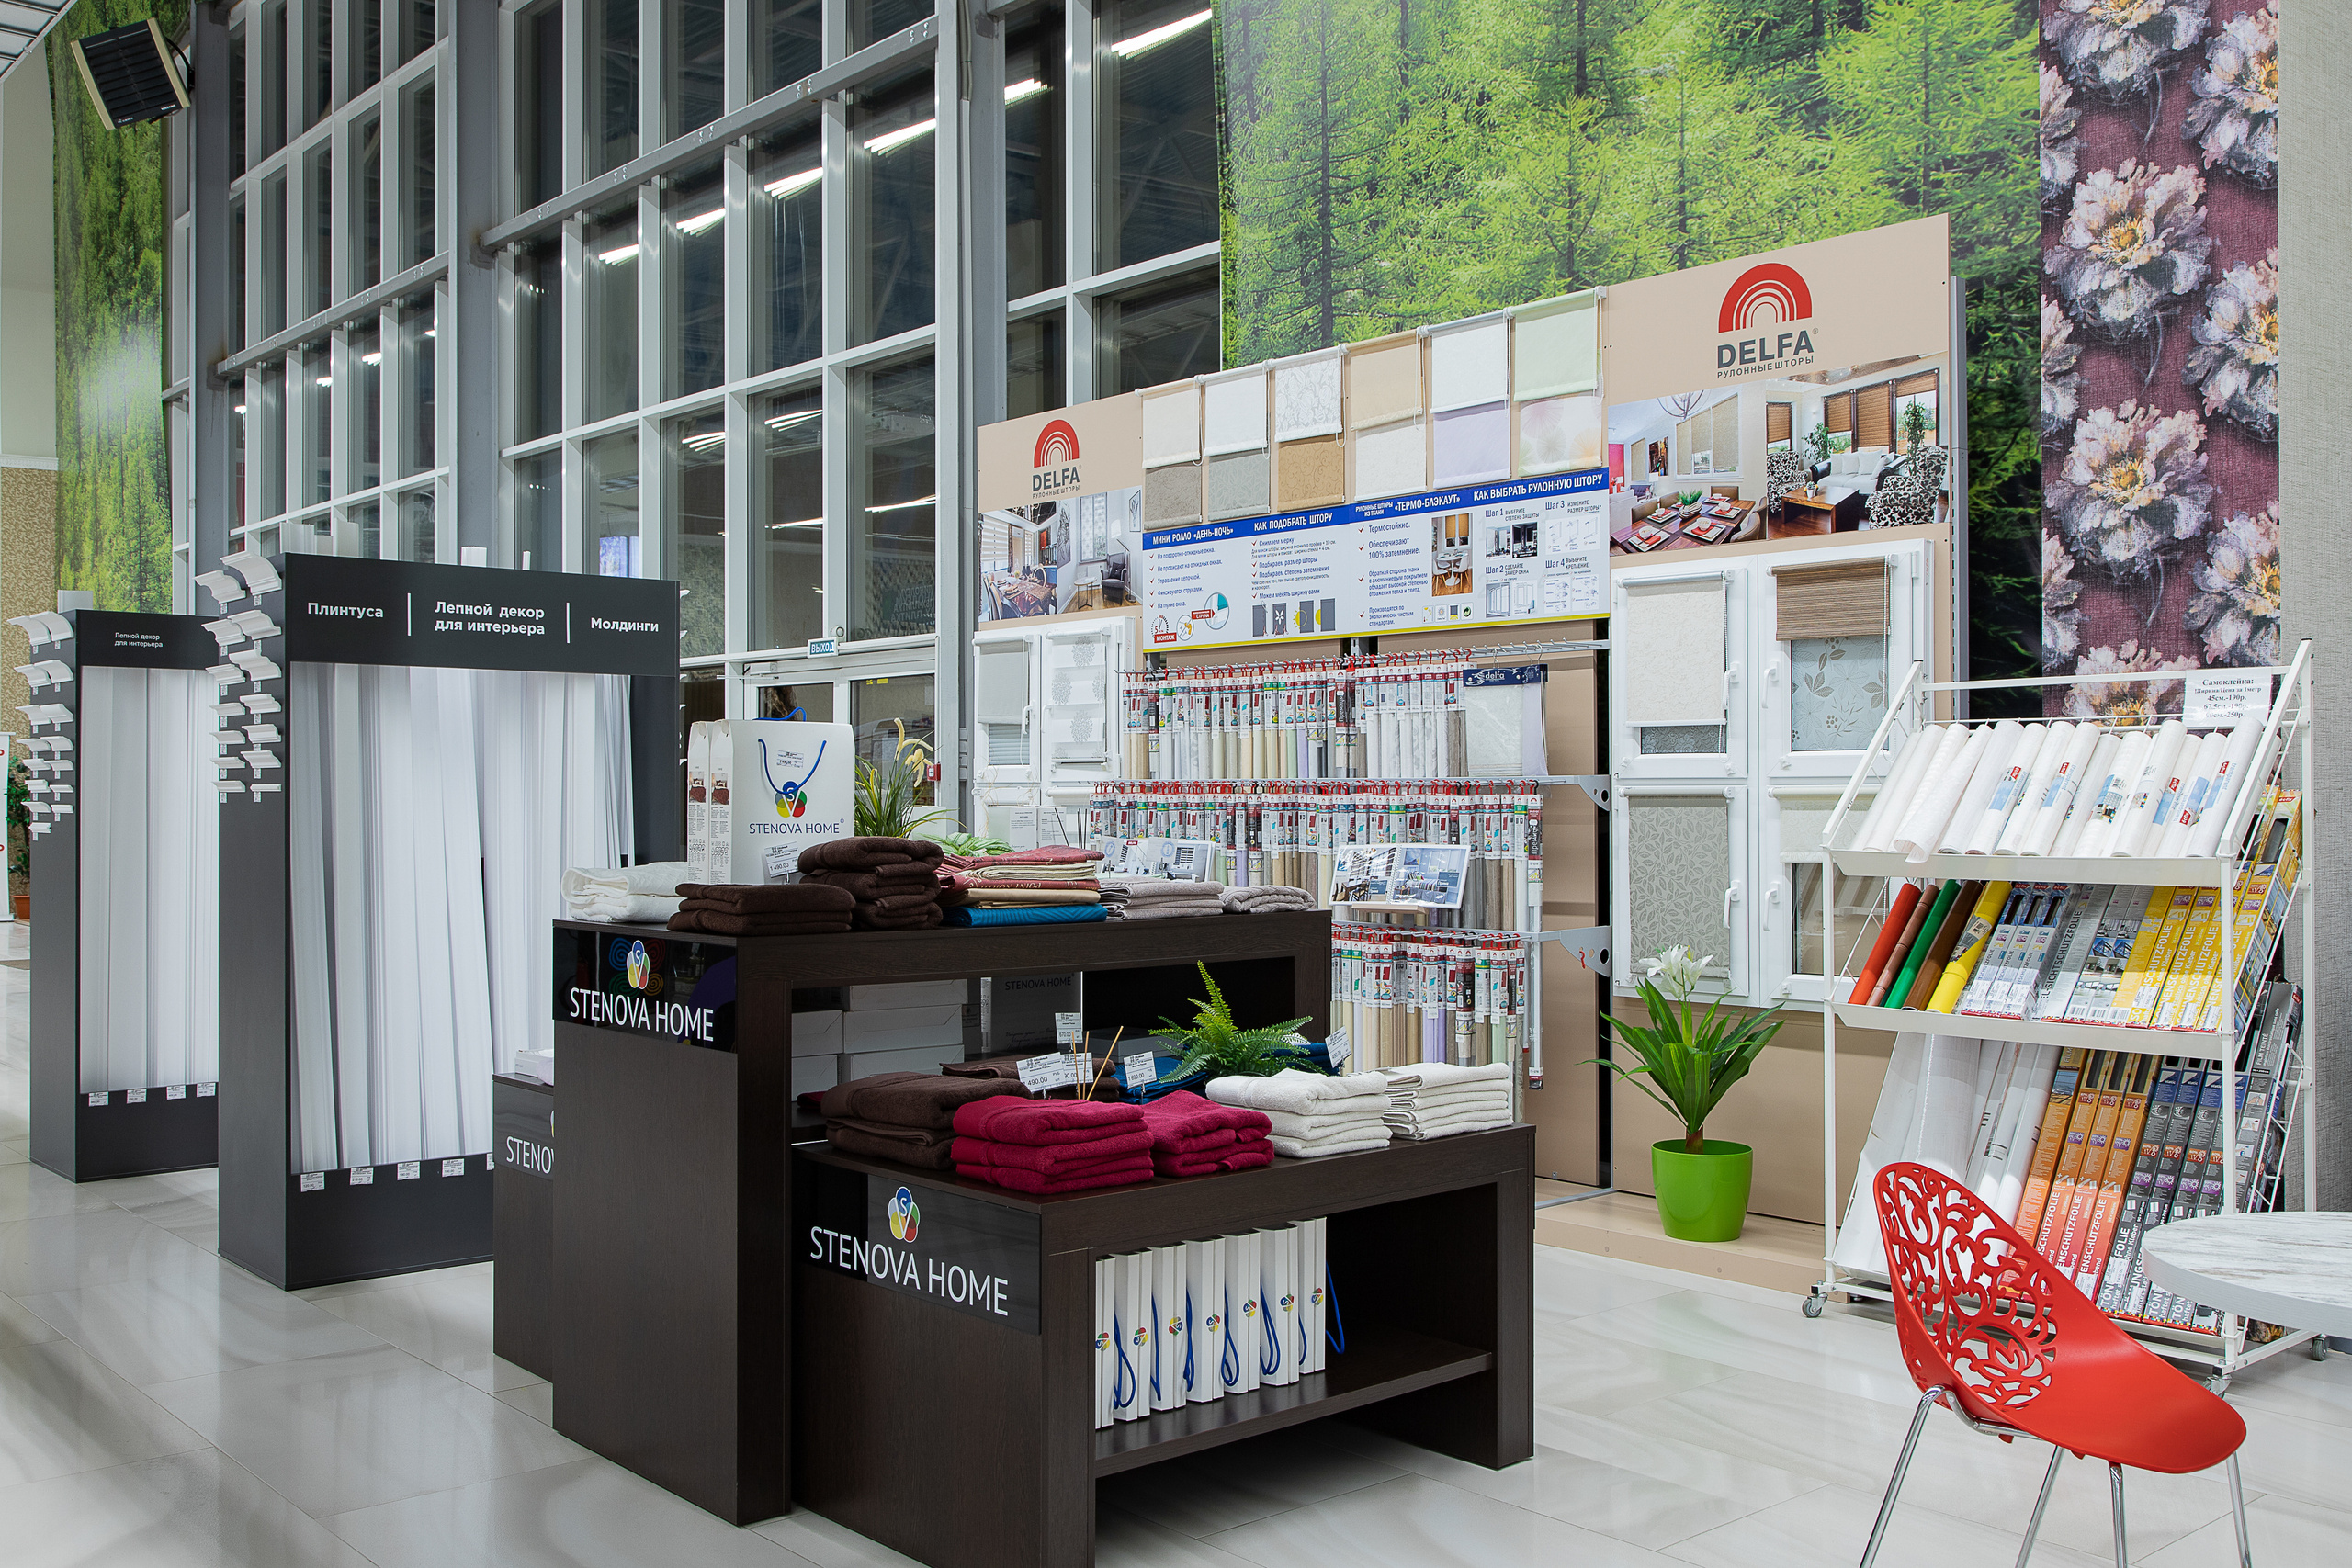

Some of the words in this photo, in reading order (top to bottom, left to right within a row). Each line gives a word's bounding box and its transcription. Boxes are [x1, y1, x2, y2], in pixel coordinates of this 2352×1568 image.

[1717, 330, 1815, 368] DELFA
[1717, 363, 1772, 379] РУЛОННЫЕ
[1774, 355, 1814, 370] ШТОРЫ
[1033, 466, 1080, 491] DELFA
[1033, 489, 1060, 499] РУЛОННЫЕ
[1060, 485, 1080, 494] ШТОРЫ
[1474, 491, 1489, 502] КАК
[1490, 484, 1527, 499] ВЫБРАТЬ
[1528, 478, 1572, 493] РУЛОННУЮ
[1574, 474, 1603, 488] ШТОРУ
[1355, 503, 1377, 513] РУЛОННЫЕ
[1377, 502, 1394, 510] ШТОРЫ
[1395, 493, 1460, 512] «ТЕРМО-БЛЭКАУТ»
[1545, 502, 1559, 511] Шаг
[1560, 501, 1565, 509] 3
[1254, 521, 1267, 532] КАК
[1269, 516, 1307, 530] ПОДОБРАТЬ
[1309, 513, 1333, 525] ШТОРУ
[1485, 510, 1499, 518] Шаг
[1152, 535, 1170, 545] МИНИ
[1172, 531, 1192, 542] РОЛЛО
[1193, 526, 1234, 541] «ДЕНЬ-НОЧЬ»
[1369, 522, 1410, 534] Термостойкие.
[1368, 537, 1409, 550] Обеспечивают
[1369, 550, 1385, 559] 100%
[1385, 547, 1420, 558] затемнение.
[1485, 566, 1498, 574] Шаг
[1498, 565, 1504, 573] 2
[1545, 559, 1559, 569] Шаг
[1560, 558, 1565, 567] 4
[307, 602, 384, 619] Плинтуса
[435, 601, 492, 617] Лепной
[499, 605, 545, 620] декор
[435, 619, 463, 632] для
[467, 620, 545, 636] интерьера
[591, 616, 659, 634] Молдинги
[1156, 634, 1175, 642] МОНТАЖ
[811, 641, 834, 653] ВЫХОД
[1485, 671, 1505, 680] delfa
[2202, 678, 2254, 686] Самоклейка:
[749, 823, 803, 834] STENOVA
[806, 823, 840, 834] HOME
[1005, 979, 1046, 991] STENOVA
[1047, 976, 1071, 987] HOME
[570, 987, 650, 1031] STENOVA
[656, 1000, 714, 1042] HOME
[2057, 1195, 2083, 1267] ENSCHUTZFOLIE
[2080, 1199, 2107, 1273] ENSCHUTZFOLIE
[2129, 1224, 2139, 1246] Kleber
[809, 1225, 921, 1290] STENOVA
[928, 1258, 1009, 1316] HOME
